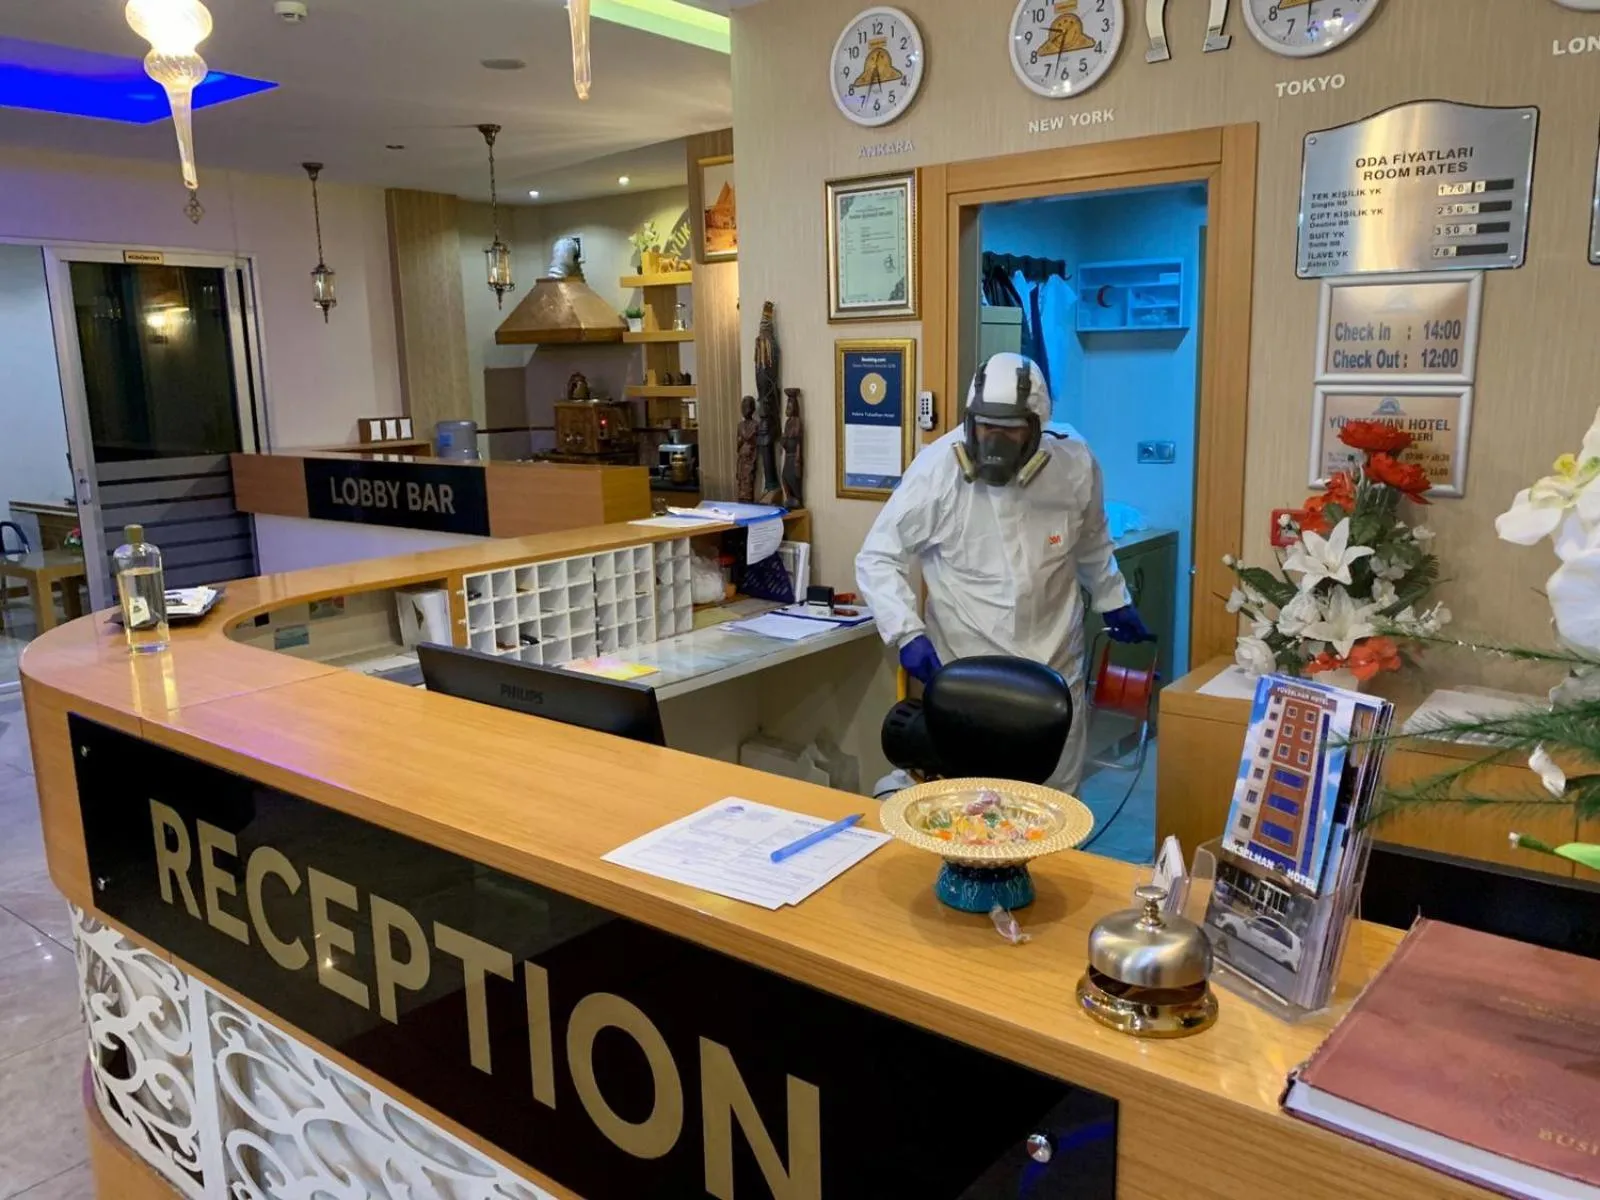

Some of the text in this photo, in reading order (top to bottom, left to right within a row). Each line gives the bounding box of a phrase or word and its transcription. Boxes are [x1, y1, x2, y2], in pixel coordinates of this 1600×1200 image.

[1032, 9, 1045, 23] 10
[1268, 6, 1278, 21] 8
[872, 22, 883, 35] 12
[1101, 18, 1110, 32] 3
[1287, 19, 1295, 35] 7
[857, 32, 867, 44] 11
[900, 37, 908, 50] 2
[1024, 31, 1033, 45] 9
[848, 47, 859, 59] 10
[1094, 40, 1103, 53] 4
[1030, 51, 1038, 64] 8
[1044, 64, 1052, 78] 7
[1079, 58, 1088, 72] 5
[843, 67, 850, 79] 9
[1060, 67, 1069, 81] 6
[848, 83, 855, 97] 8
[1275, 74, 1346, 98] TOKYO
[860, 95, 867, 109] 7
[888, 91, 896, 103] 5
[873, 98, 881, 111] 6
[1028, 108, 1115, 133] NEW YORK
[857, 140, 915, 158] ANKARA
[1355, 147, 1474, 168] ODA FİYATLARI
[1363, 161, 1468, 181] ROOM RATES
[1312, 192, 1329, 200] TEK
[1334, 321, 1374, 341] Check
[1379, 323, 1391, 341] In
[1423, 319, 1461, 340] 14:00
[1333, 349, 1372, 368] Check
[1376, 349, 1400, 368] Out
[1421, 348, 1459, 368] 12:00
[869, 383, 877, 394] 9
[1408, 418, 1451, 431] HOTEL
[330, 476, 456, 514] LOBBY BAR
[500, 683, 543, 704] PHILIPS
[150, 798, 821, 1200] RECEPTION
